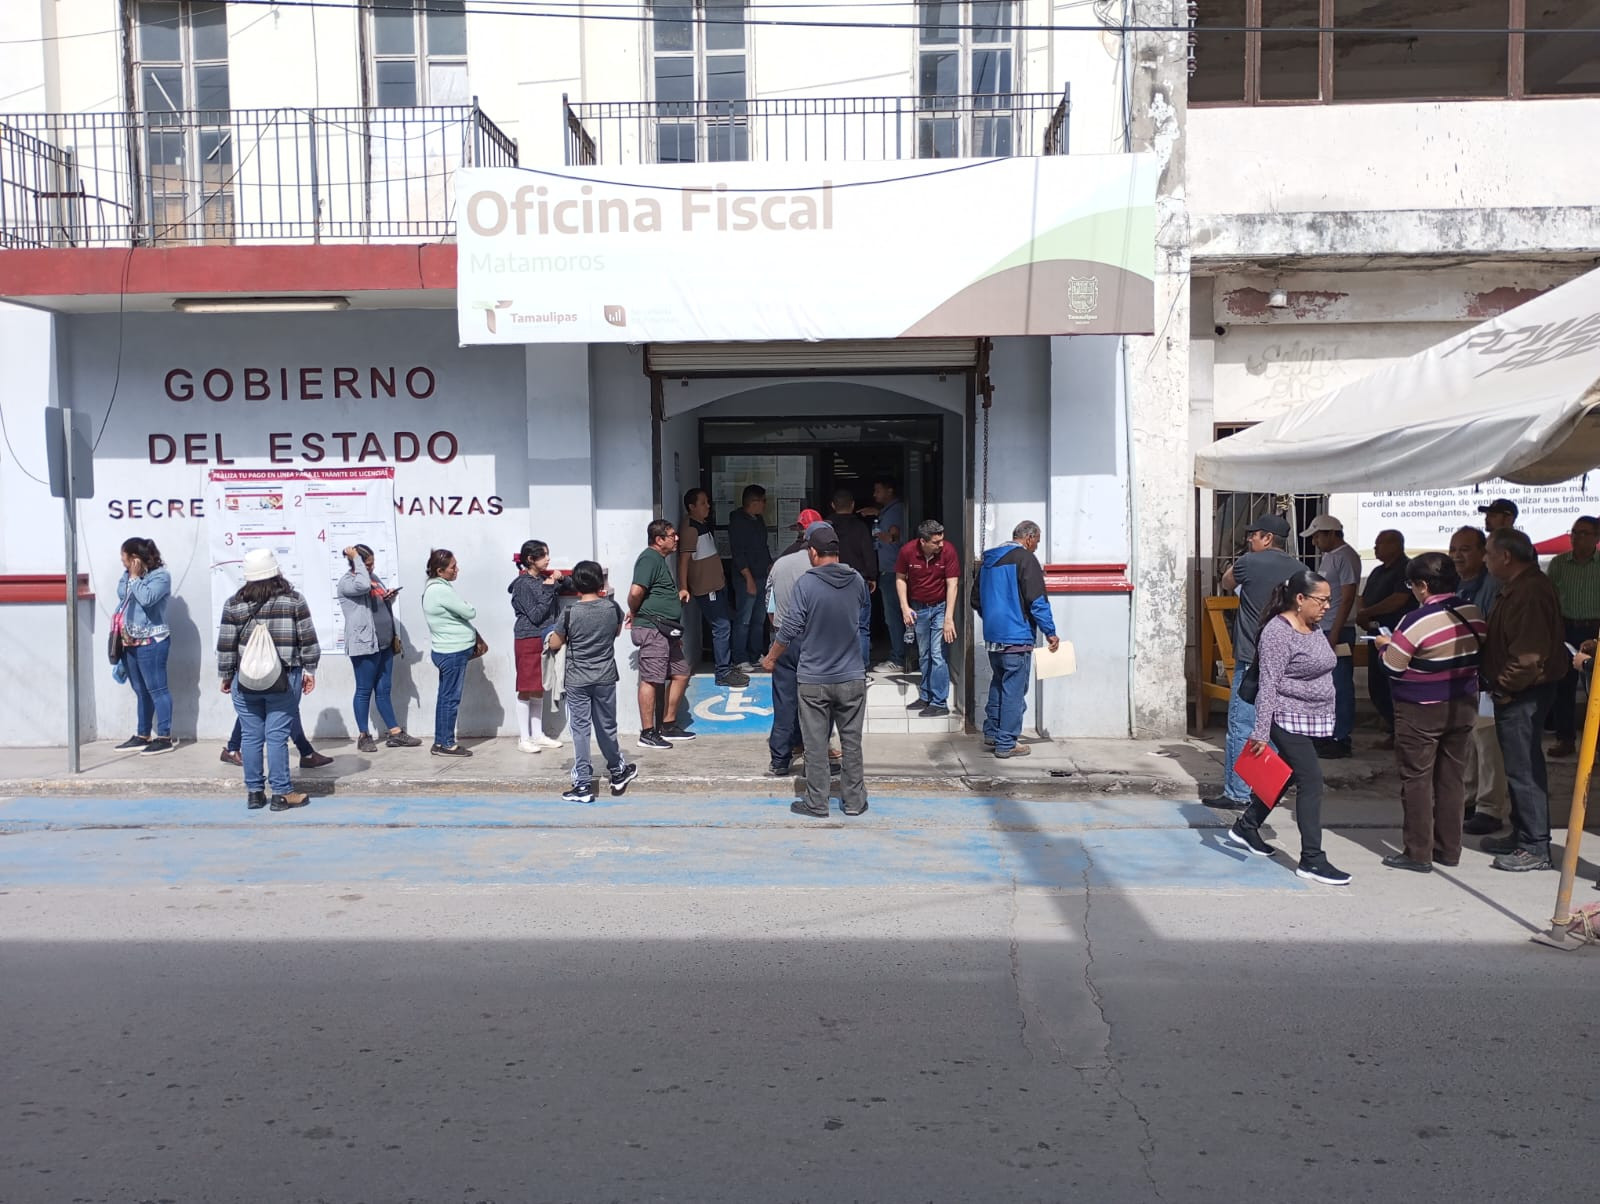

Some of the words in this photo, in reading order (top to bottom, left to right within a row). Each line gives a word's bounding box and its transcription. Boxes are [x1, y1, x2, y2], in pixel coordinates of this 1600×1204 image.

[466, 184, 662, 237] Oficina
[681, 180, 833, 231] Fiscal
[470, 252, 606, 274] Matamoros
[510, 311, 577, 324] Tamaulipas
[164, 366, 436, 401] GOBIERNO
[148, 432, 234, 465] DEL
[269, 430, 459, 463] ESTADO
[1486, 486, 1507, 496] pide
[1509, 486, 1520, 494] de
[108, 499, 205, 519] SECRE
[394, 495, 504, 517] NANZAS
[216, 498, 221, 510] 1
[294, 495, 302, 507] 2
[1362, 500, 1392, 508] cordial
[1408, 499, 1456, 508] abstengan
[1458, 498, 1470, 506] de
[1472, 497, 1492, 505] veni
[1513, 496, 1541, 504] ealizar
[1521, 506, 1530, 514] el
[1532, 505, 1580, 514] interesado
[1438, 525, 1454, 533] Por
[225, 532, 233, 546] 3
[317, 529, 326, 543] 4
